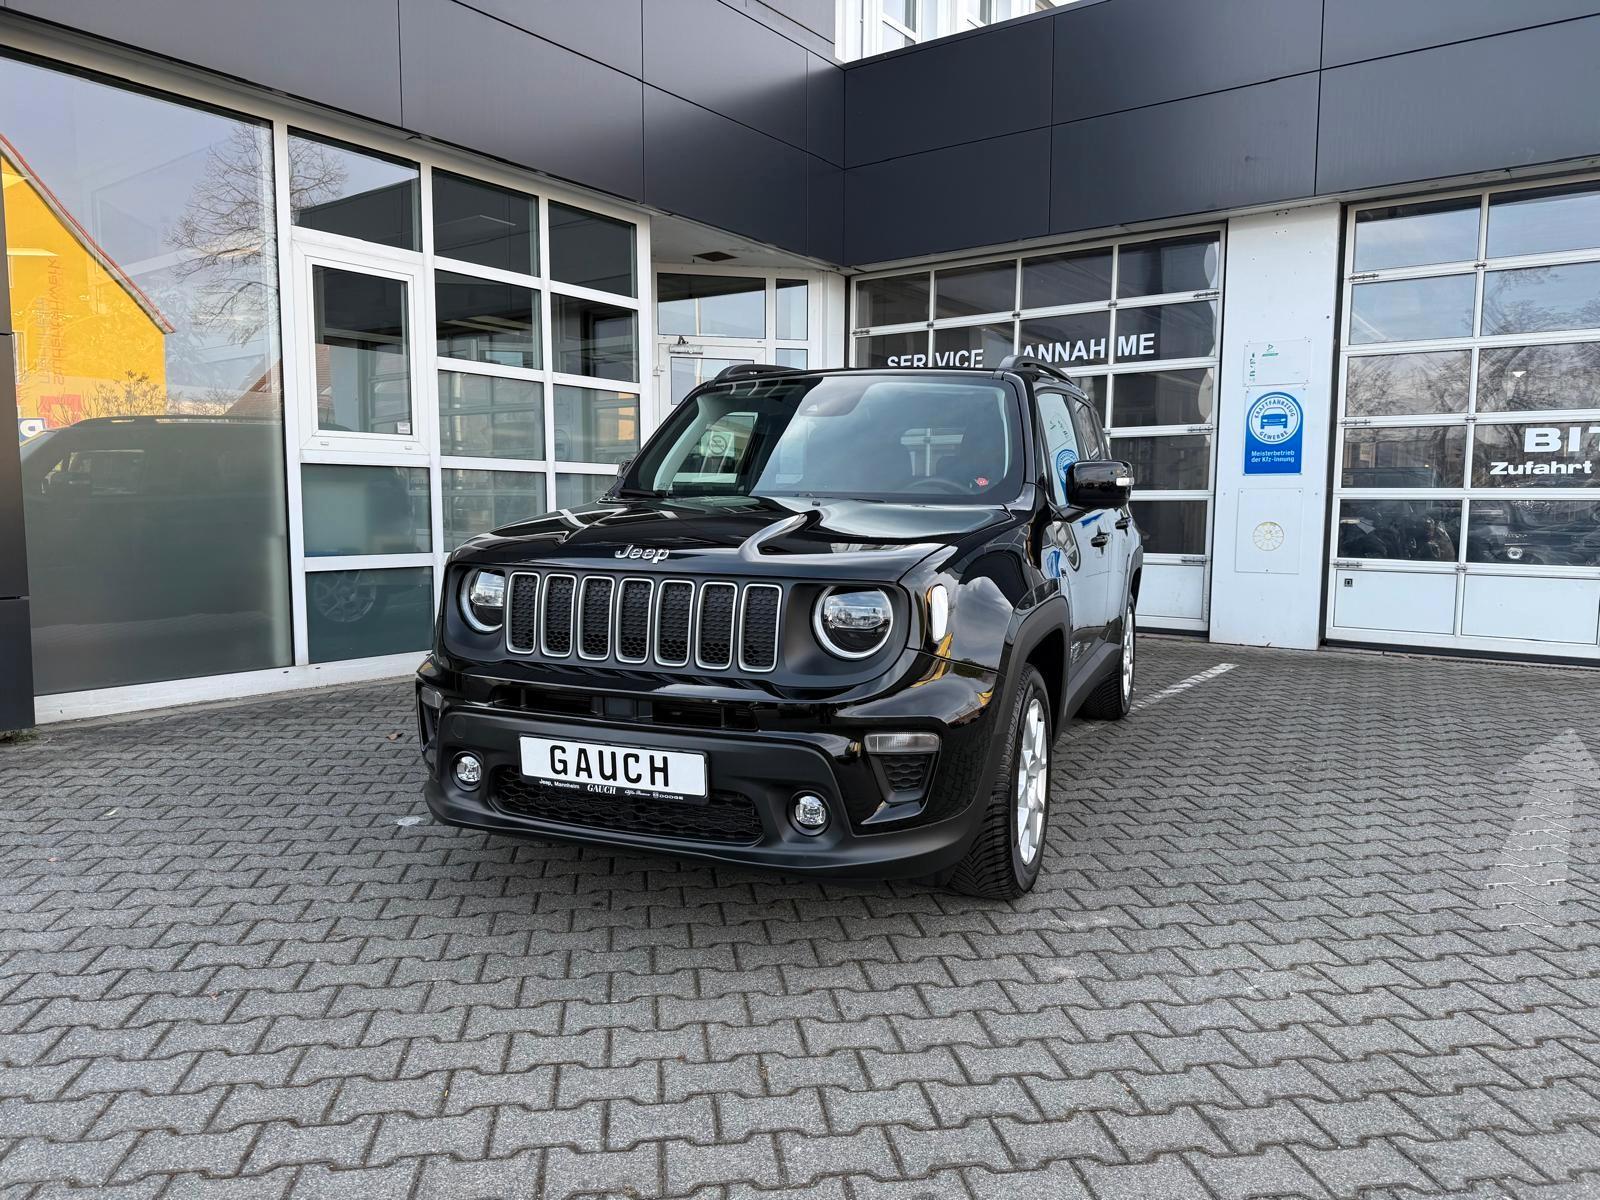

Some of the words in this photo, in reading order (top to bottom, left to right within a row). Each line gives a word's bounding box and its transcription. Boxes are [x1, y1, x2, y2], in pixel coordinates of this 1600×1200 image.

[887, 348, 984, 369] SERVICE
[1023, 333, 1155, 364] ANNAHME
[1489, 460, 1593, 475] Zufahrt
[614, 544, 670, 564] Jeep
[549, 744, 670, 788] GAUCH
[554, 781, 580, 789] Mannheim
[587, 784, 617, 795] GAUCH
